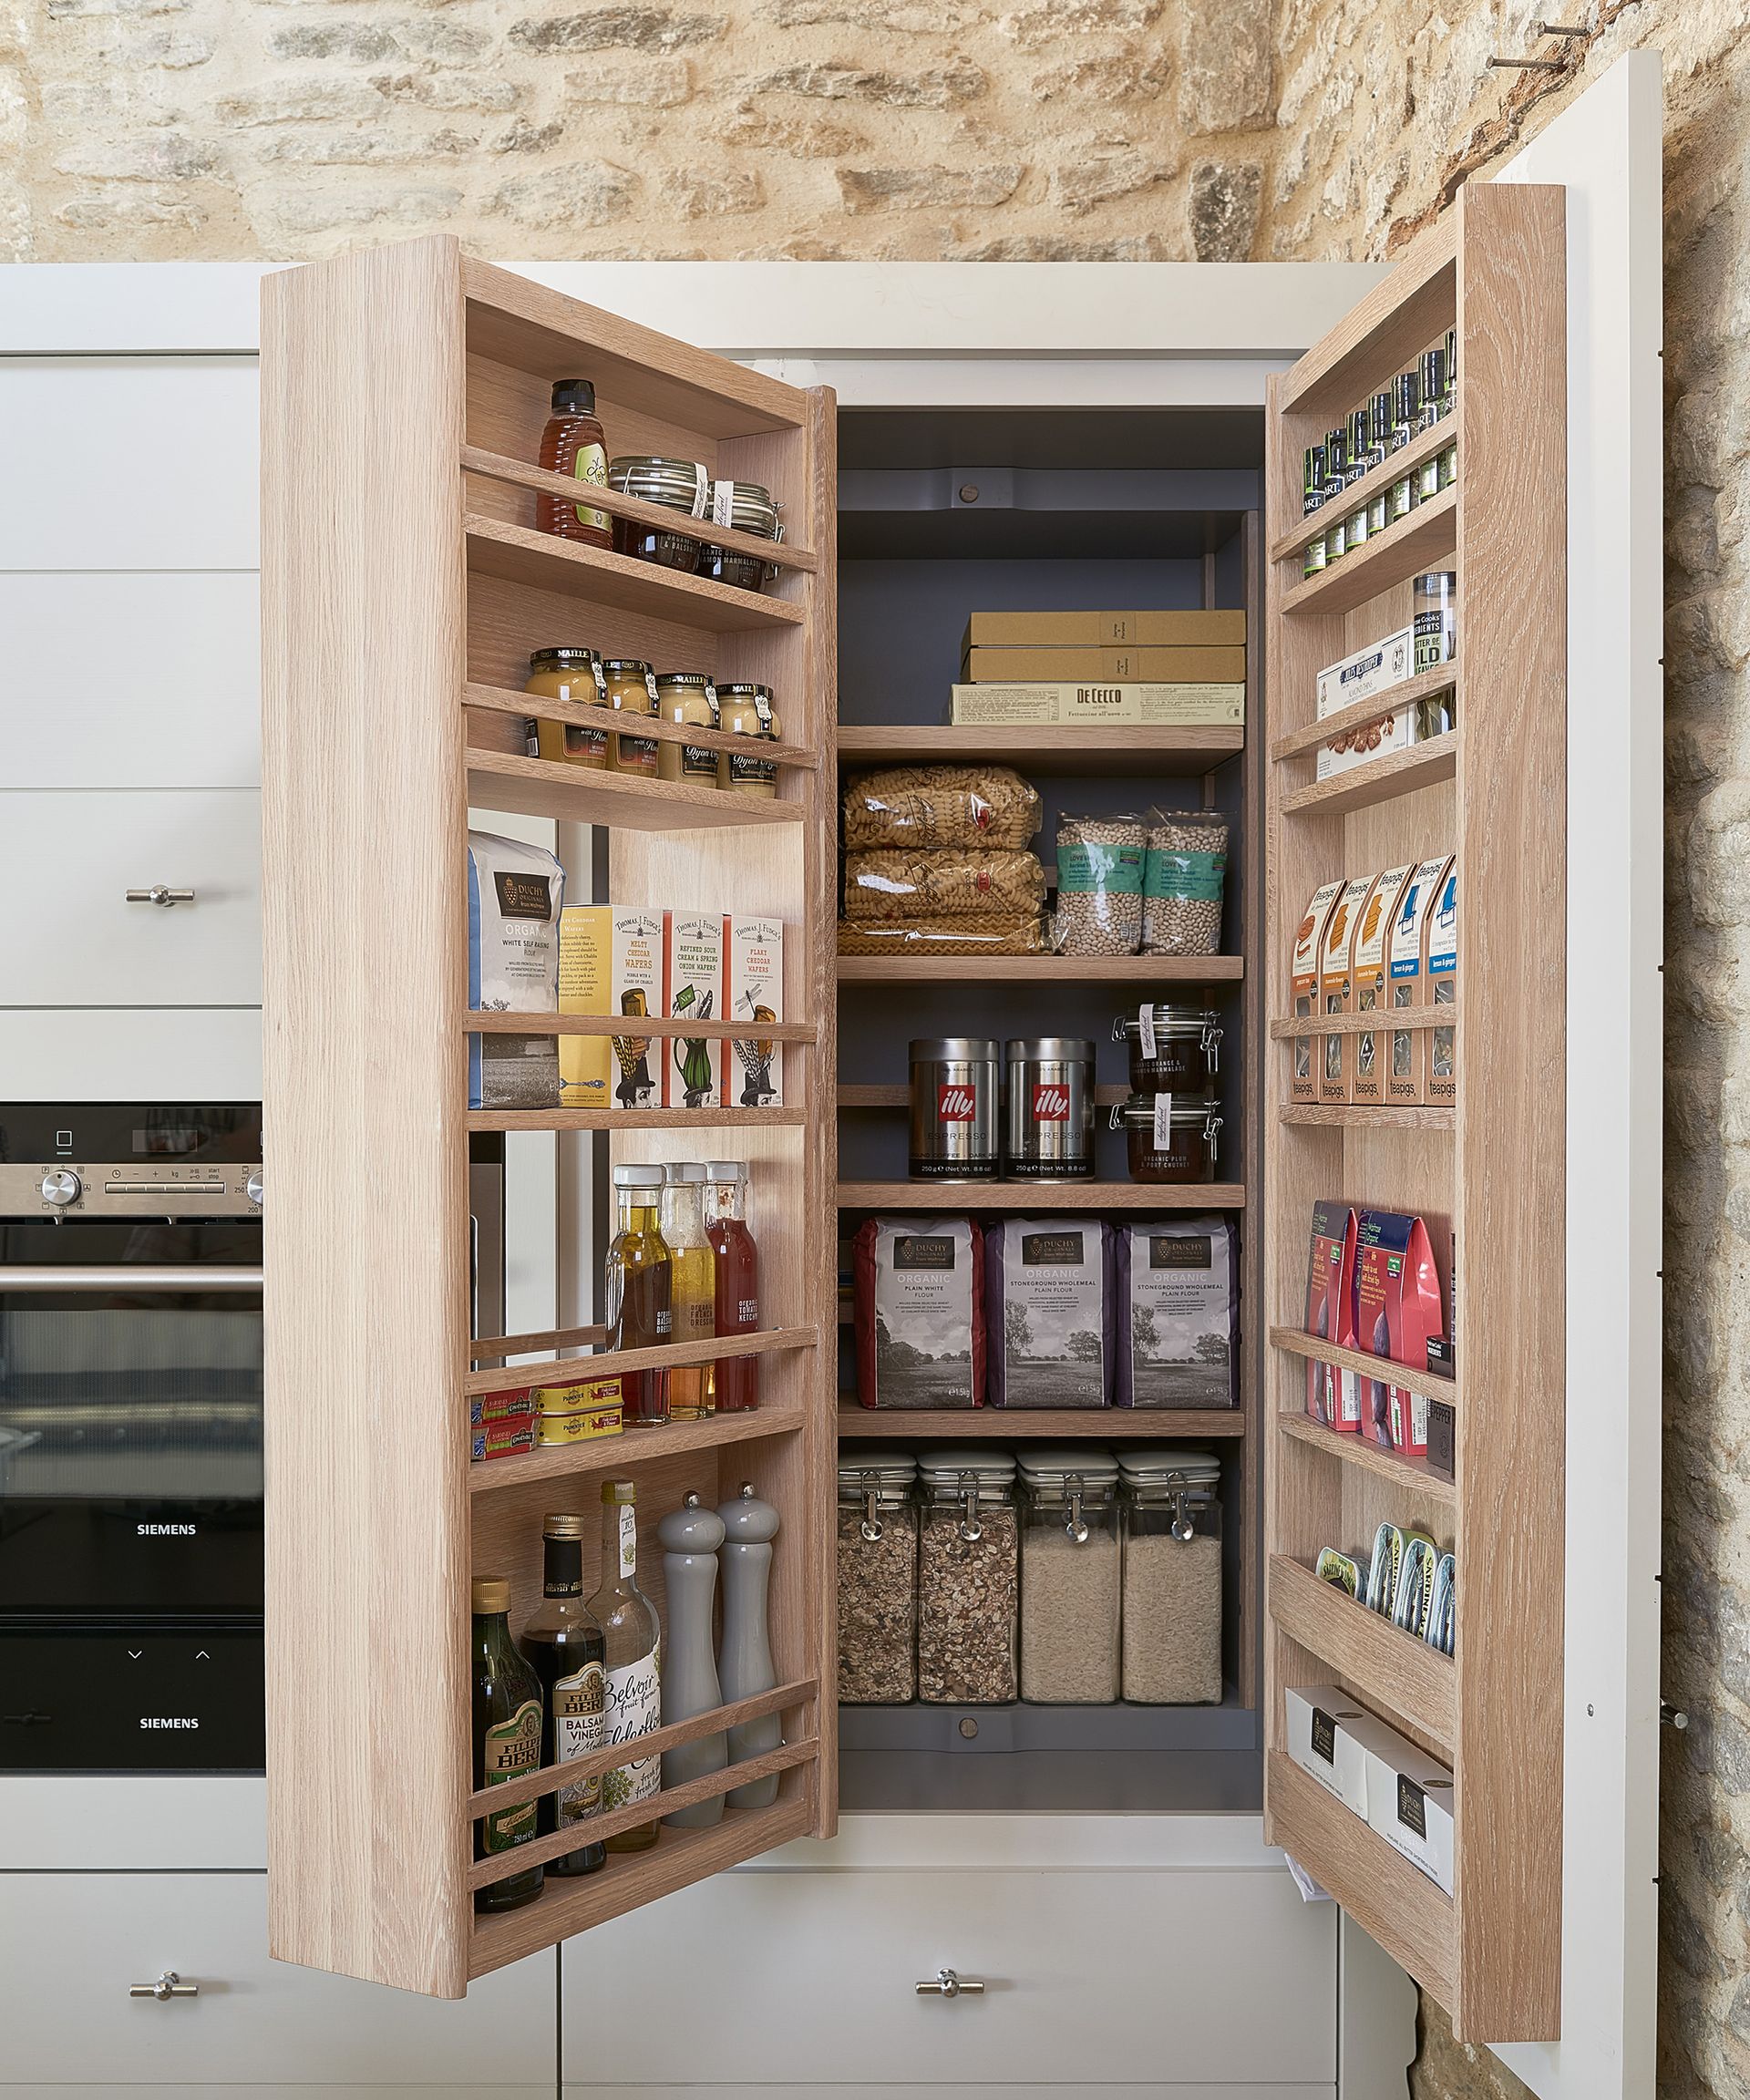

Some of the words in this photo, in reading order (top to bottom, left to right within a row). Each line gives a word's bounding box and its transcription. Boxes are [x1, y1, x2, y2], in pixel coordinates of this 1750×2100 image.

[558, 650, 589, 658] MAILLE
[518, 885, 543, 896] DUCHY
[680, 945, 702, 953] REFINED
[625, 959, 652, 969] WAFERS
[1151, 1065, 1186, 1073] MARMALADE
[942, 1090, 973, 1118] illy
[1035, 1089, 1068, 1117] illy
[898, 1274, 950, 1283] ORGANIC
[1026, 1270, 1079, 1278] ORGANIC
[1154, 1273, 1207, 1282] ORGANIC
[624, 1521, 632, 1529] 10
[137, 1524, 196, 1536] SIEMENS
[139, 1718, 199, 1729] SIEMENS
